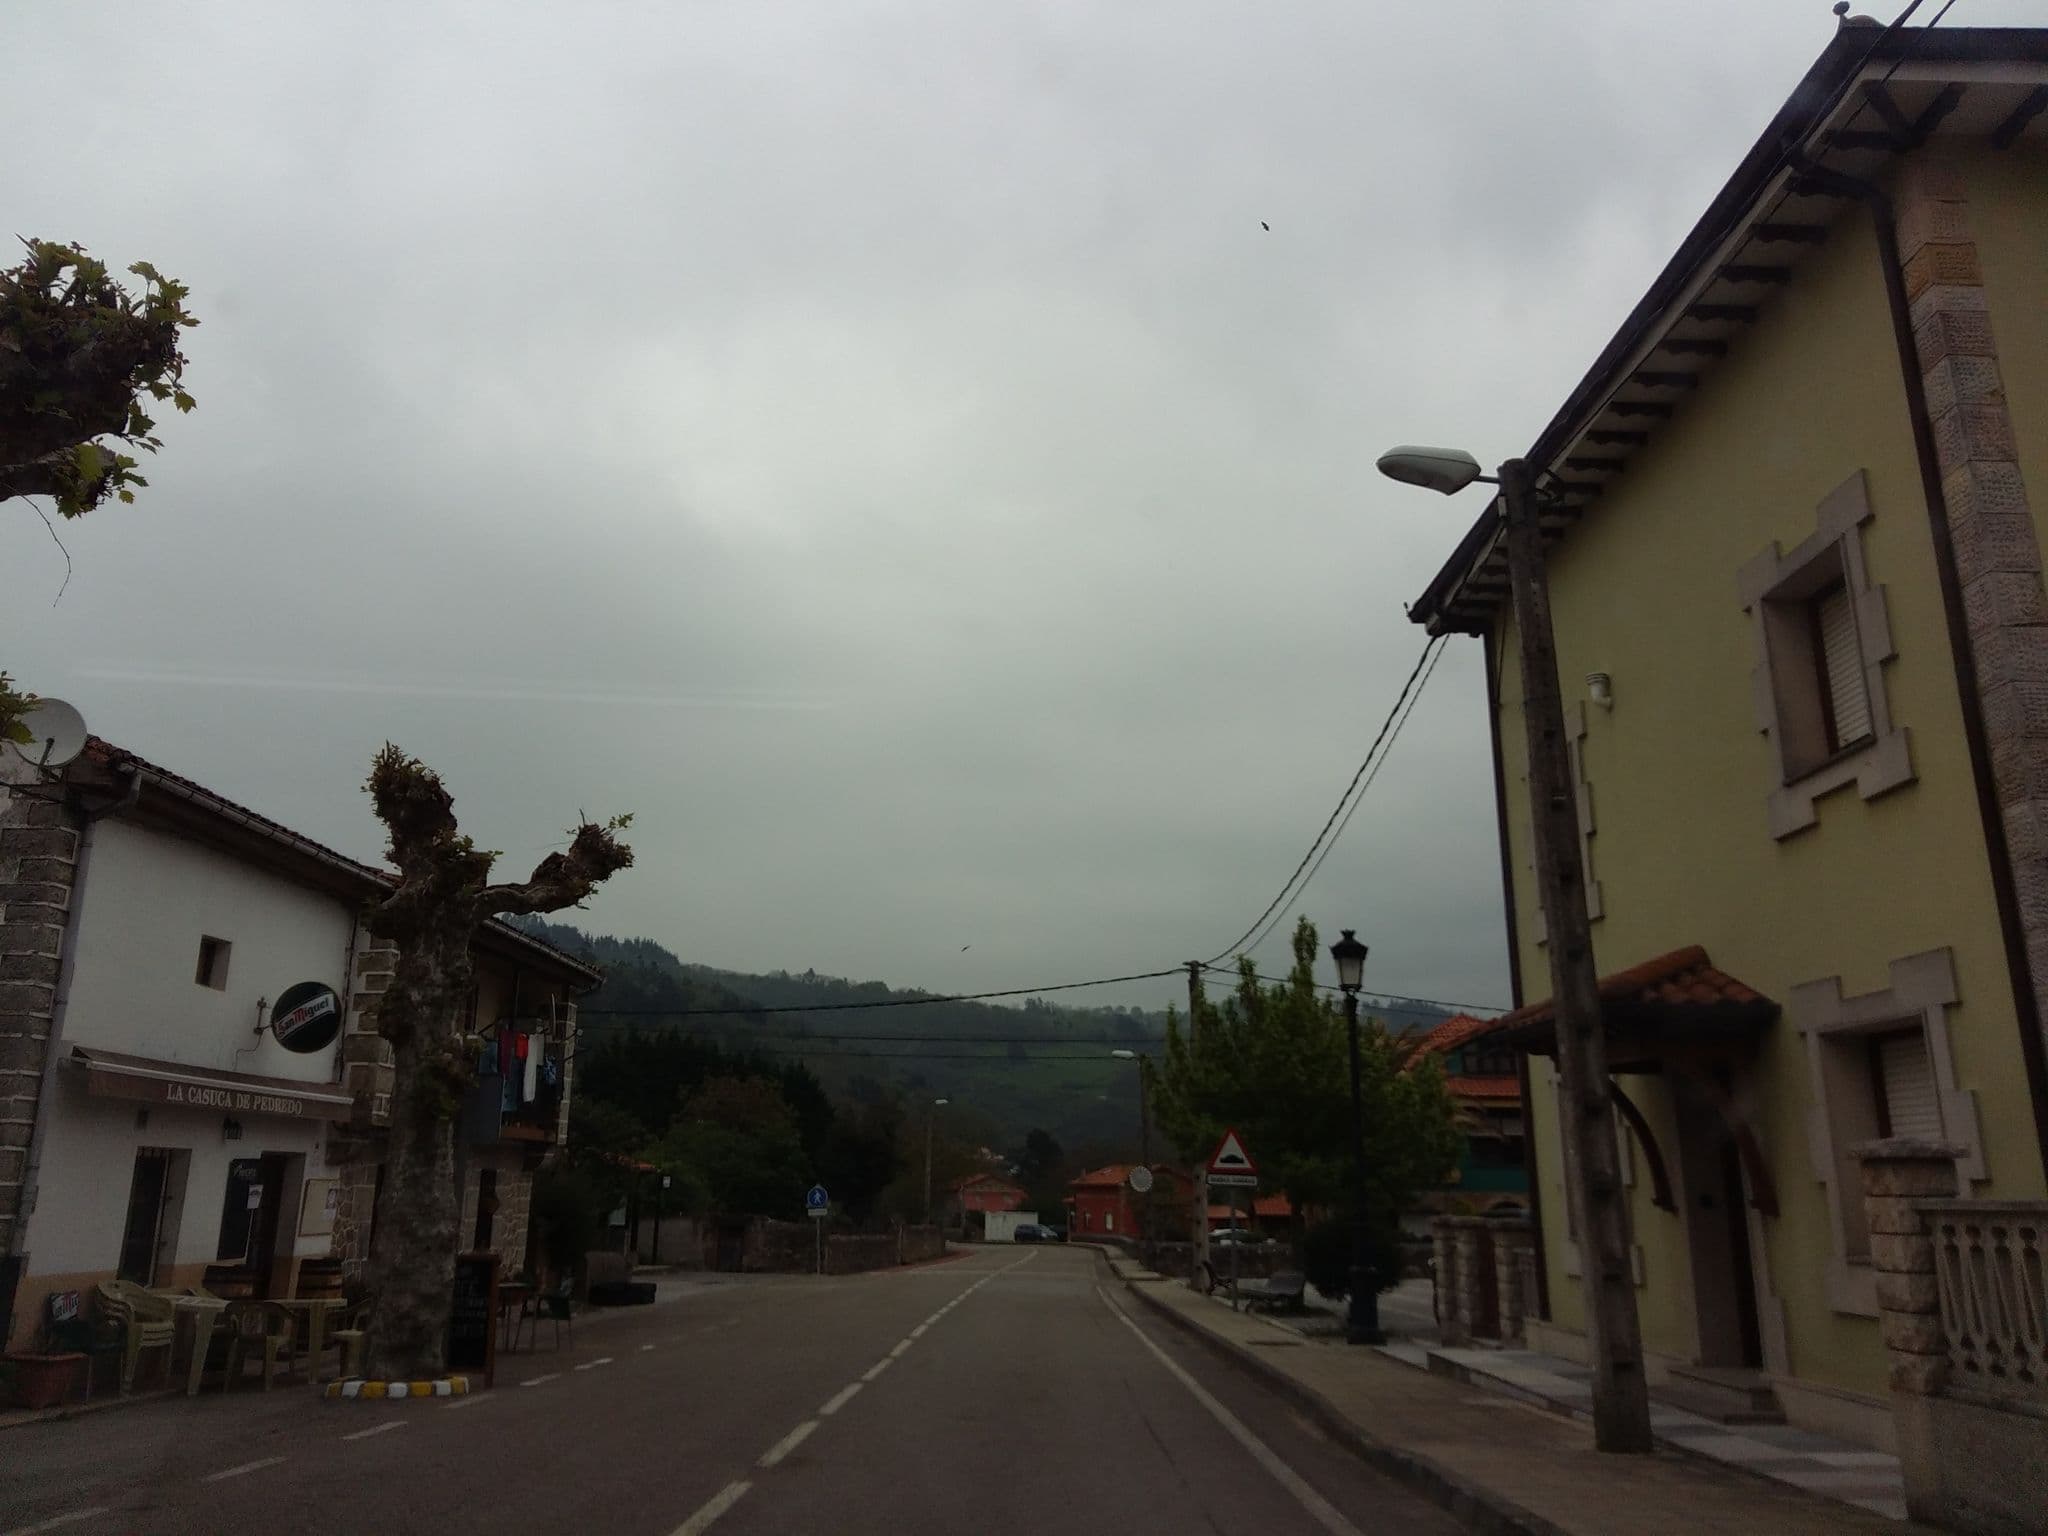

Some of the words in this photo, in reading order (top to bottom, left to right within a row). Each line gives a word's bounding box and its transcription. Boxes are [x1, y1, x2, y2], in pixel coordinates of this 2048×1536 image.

[166, 1083, 184, 1102] LA
[188, 1086, 233, 1108] CASUCA
[236, 1093, 250, 1110] DE
[253, 1095, 304, 1115] PEDREDO
